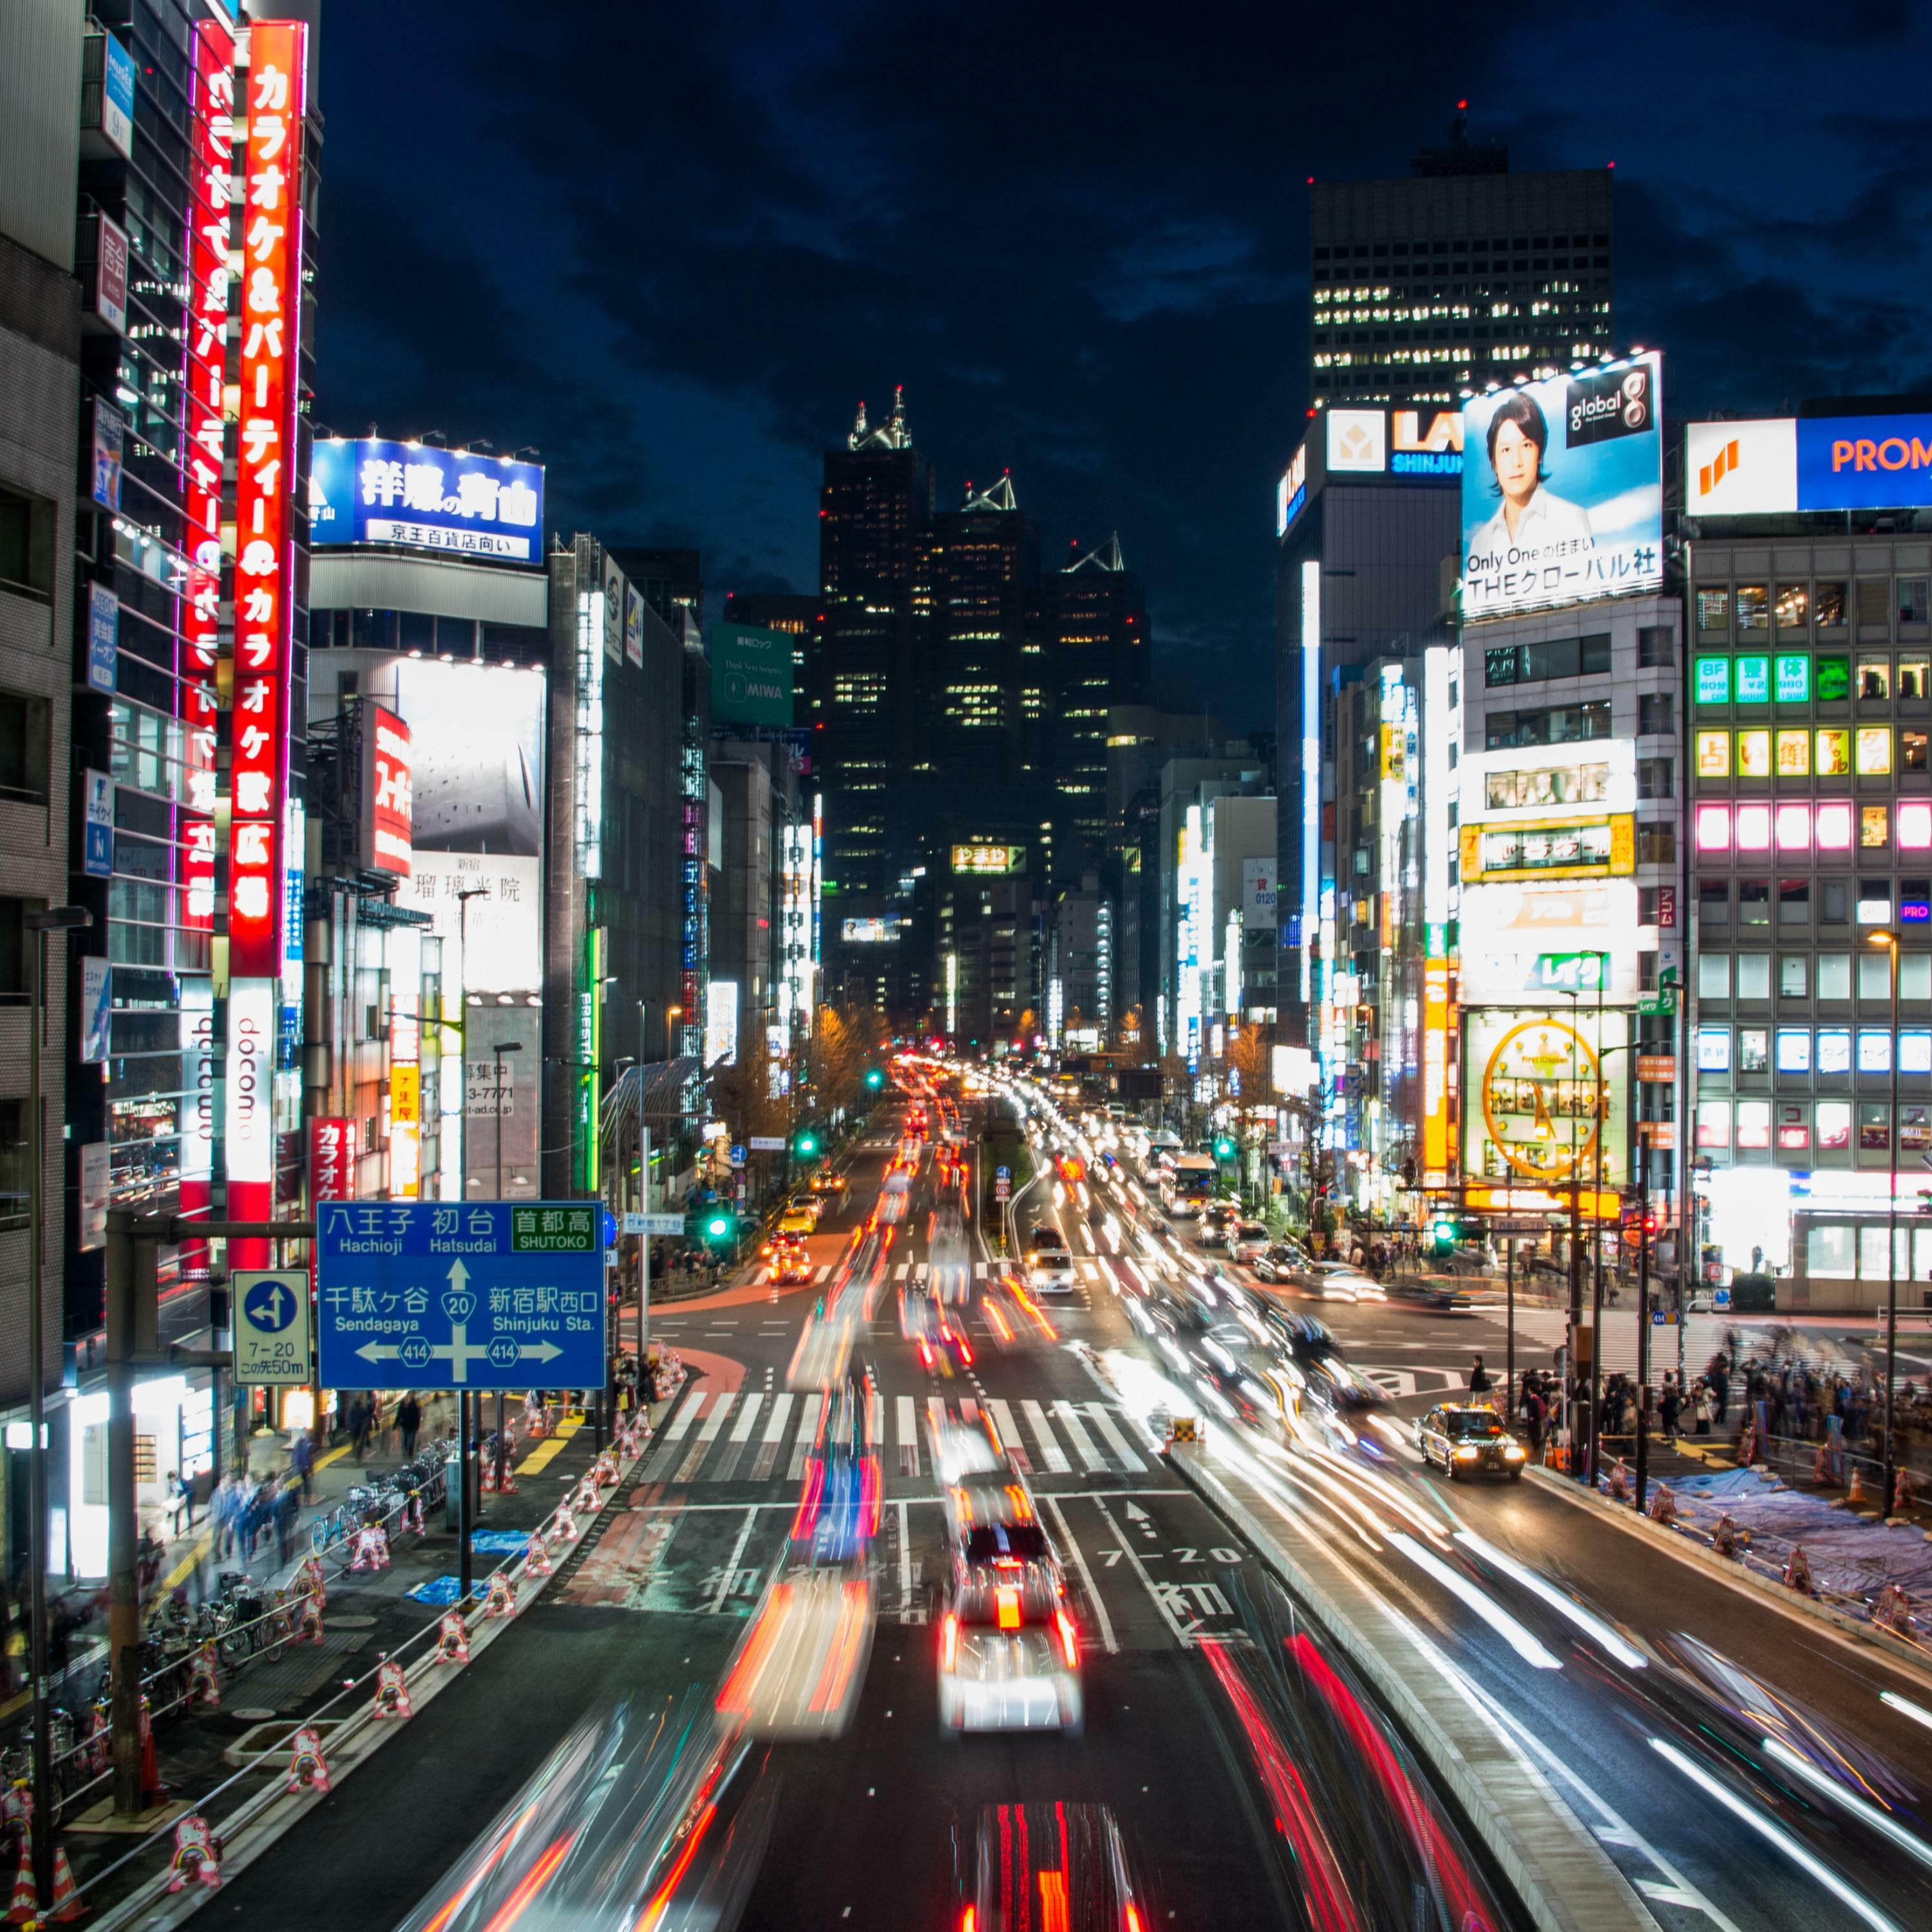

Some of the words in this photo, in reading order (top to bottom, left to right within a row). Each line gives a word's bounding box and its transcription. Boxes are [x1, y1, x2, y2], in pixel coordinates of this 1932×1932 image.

[1570, 390, 1620, 431] global
[360, 460, 537, 527] 洋服の青山
[391, 524, 511, 552] 京王百貨店向い
[1468, 549, 1503, 574] Only
[1508, 546, 1539, 565] One
[726, 660, 741, 670] Think
[1703, 663, 1724, 676] 8F
[747, 683, 782, 699] MIWA
[958, 848, 1005, 863] やまや
[459, 857, 480, 871] 新宿
[415, 873, 520, 902] 瑠璃光院
[1256, 893, 1275, 904] 0120
[1542, 956, 1602, 985] レイク
[238, 1018, 260, 1140] docomo
[319, 1124, 339, 1200] カラオケ
[327, 1209, 415, 1235] 八王子
[432, 1208, 495, 1235] 初台
[516, 1211, 590, 1233] 首都高
[340, 1238, 402, 1255] Hachioji
[430, 1238, 497, 1253] Hatsudai
[520, 1236, 586, 1249] SHUTOKO
[449, 1297, 469, 1314] 20
[489, 1287, 598, 1313] 新宿駅西口
[336, 1317, 419, 1333] Sendagaya
[493, 1317, 559, 1332] Shinjuku
[566, 1317, 594, 1331] Sta.
[249, 1343, 294, 1357] 7-20
[404, 1344, 426, 1359] 414
[491, 1344, 514, 1359] 414
[242, 1359, 303, 1375] この先50m
